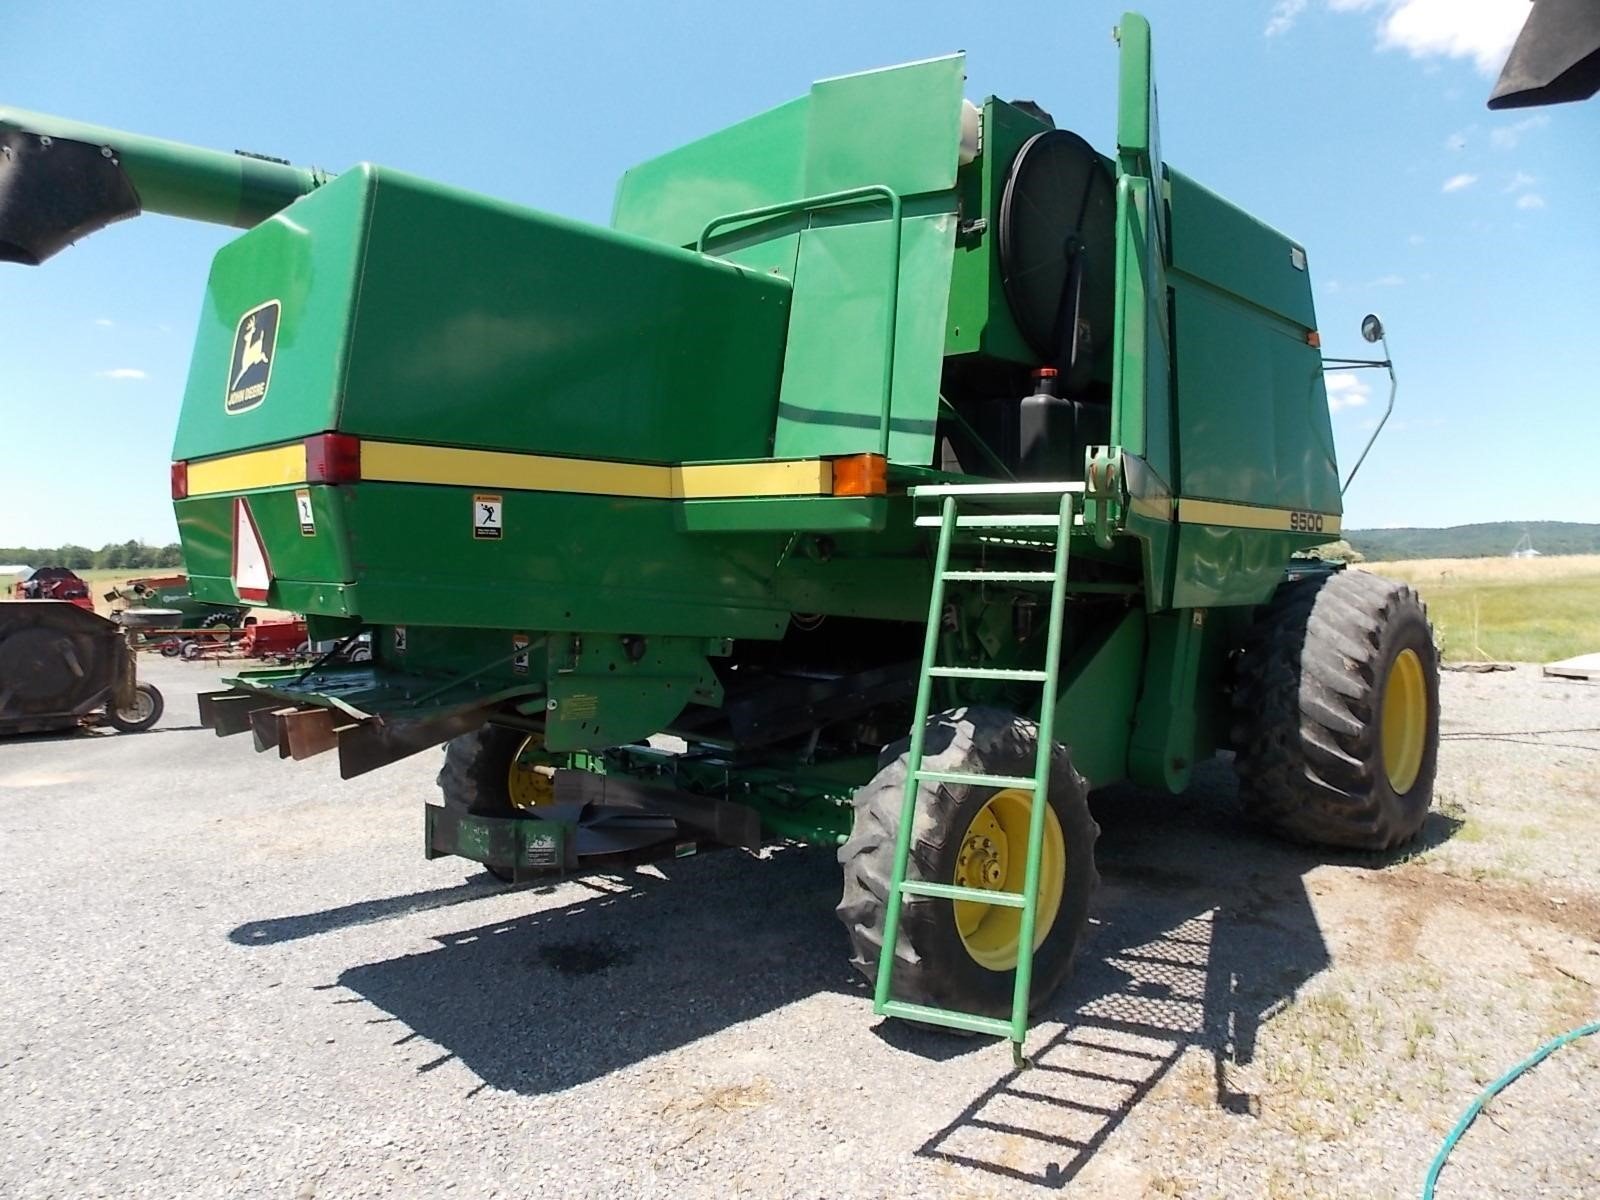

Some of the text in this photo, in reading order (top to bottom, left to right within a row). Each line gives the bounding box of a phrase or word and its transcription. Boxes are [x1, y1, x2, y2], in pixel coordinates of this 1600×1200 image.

[228, 382, 265, 406] JOHN DEERE
[1290, 511, 1323, 532] 9500
